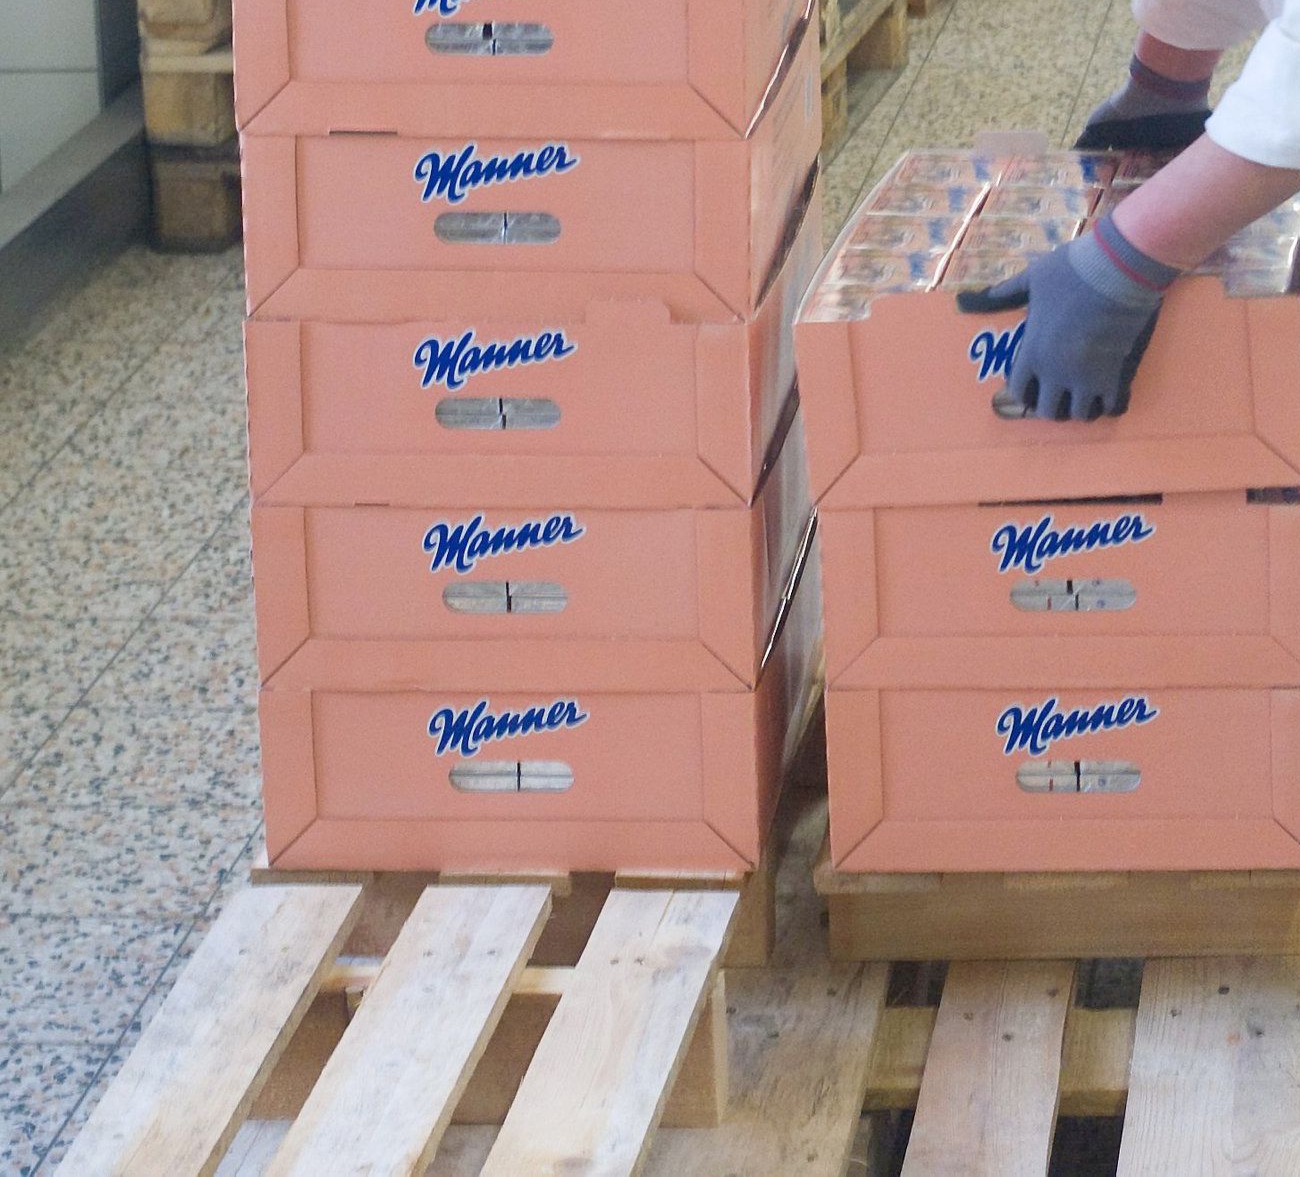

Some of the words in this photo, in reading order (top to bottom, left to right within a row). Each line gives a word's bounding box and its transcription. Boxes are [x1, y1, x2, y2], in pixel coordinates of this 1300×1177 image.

[415, 143, 576, 203] Manner
[415, 331, 575, 390] Manner
[424, 515, 582, 573] Manner
[992, 515, 1154, 573] Manner
[430, 701, 586, 757] Manner
[997, 697, 1156, 755] Manner
